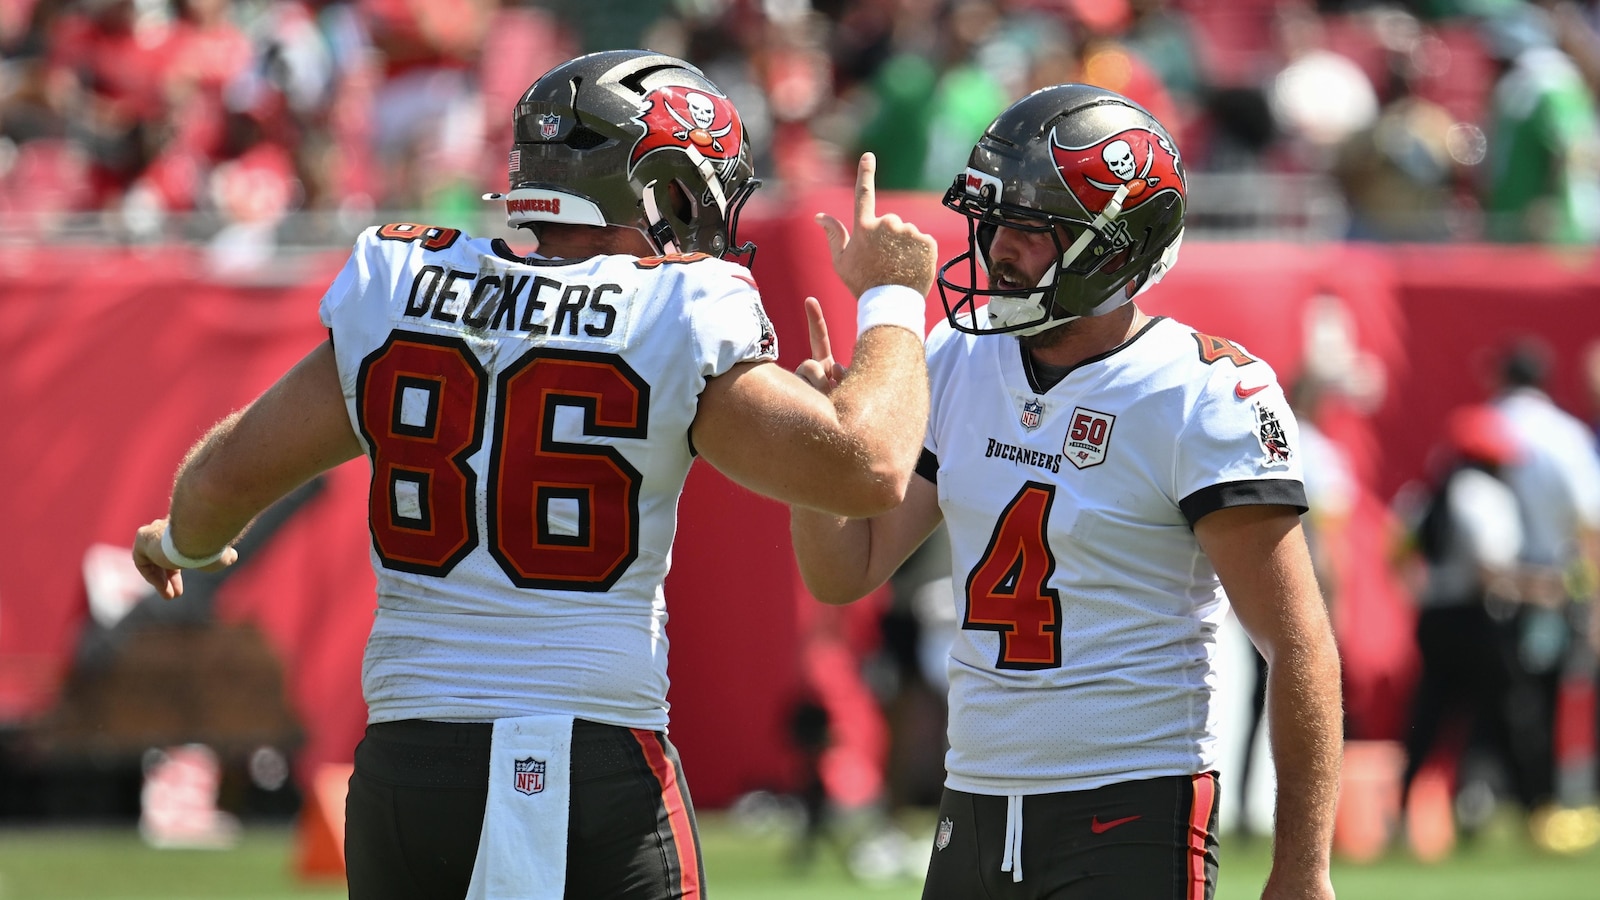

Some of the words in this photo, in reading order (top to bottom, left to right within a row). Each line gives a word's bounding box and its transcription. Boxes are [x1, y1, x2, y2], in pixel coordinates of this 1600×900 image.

[403, 264, 623, 338] DECKERS
[1190, 332, 1257, 367] 4
[1071, 413, 1108, 446] 50
[356, 328, 650, 592] 86
[984, 437, 1062, 474] BUCCANEERS
[962, 480, 1063, 671] 4
[517, 773, 541, 791] NFL
